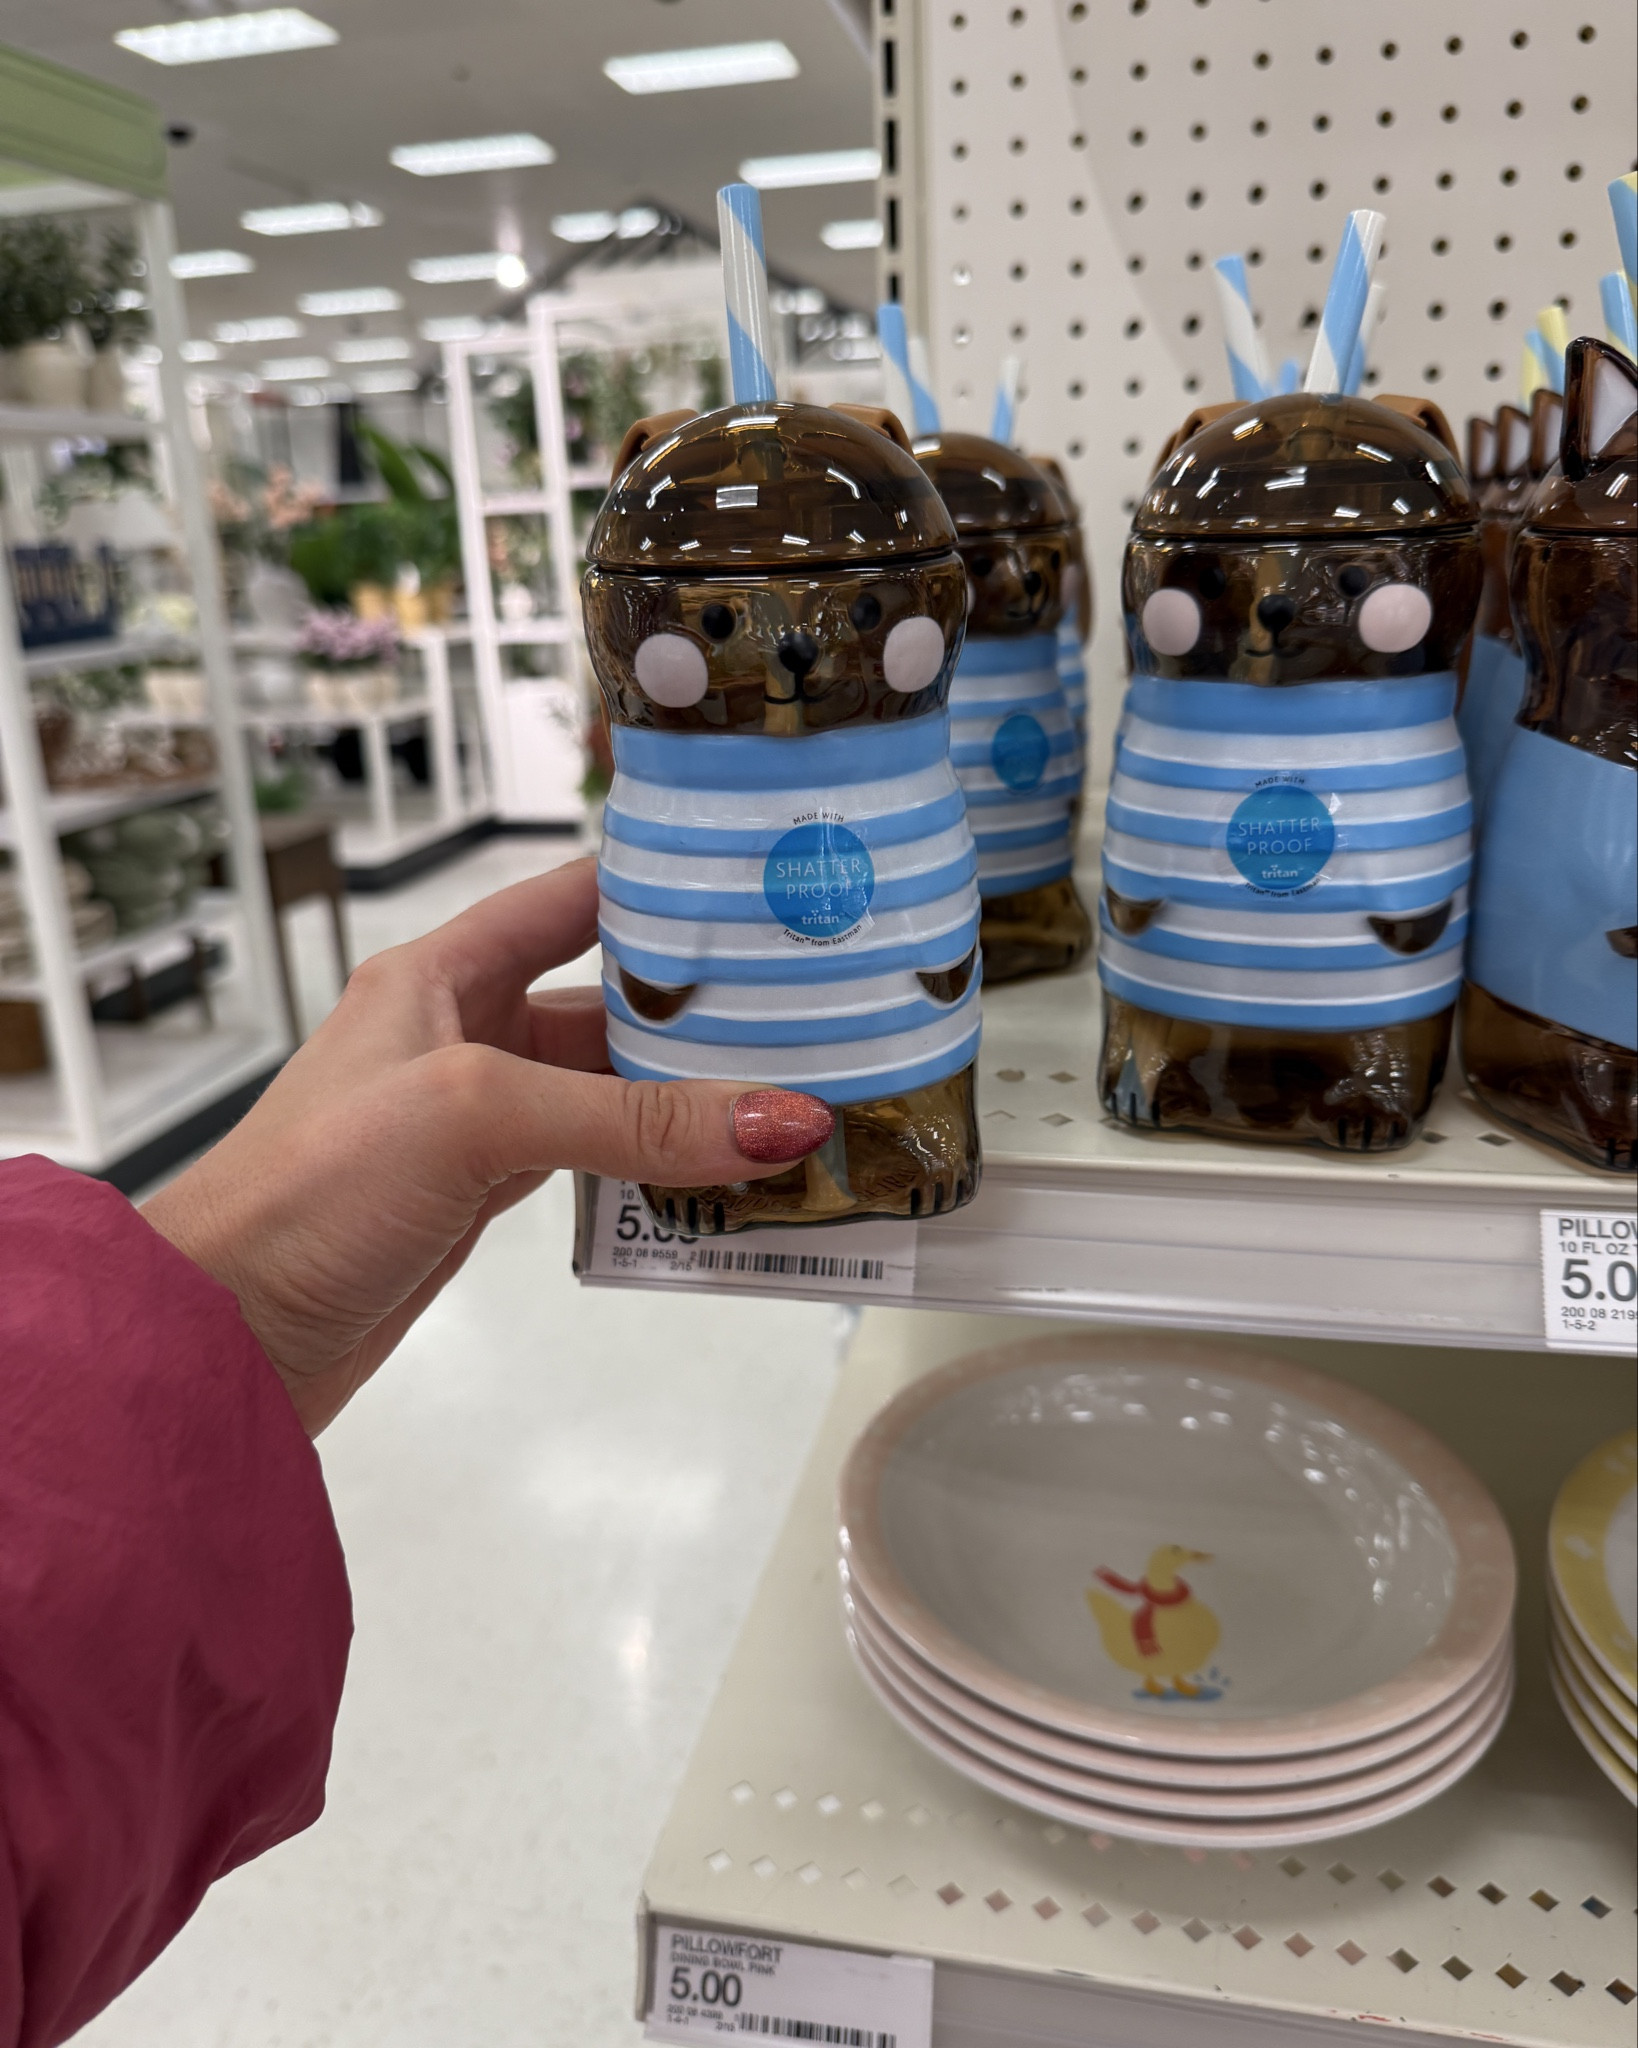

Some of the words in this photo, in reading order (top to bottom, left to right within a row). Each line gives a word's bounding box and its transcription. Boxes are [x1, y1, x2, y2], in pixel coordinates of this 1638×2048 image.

[1255, 776, 1279, 788] MADE
[1282, 776, 1305, 784] WITH
[793, 812, 819, 825] MADE
[822, 812, 845, 823] WITH
[1238, 817, 1321, 837] SHATTER
[1247, 837, 1312, 856] PROOF
[776, 858, 861, 878] SHATTER
[786, 879, 853, 900] PROOF
[811, 937, 830, 946] from
[832, 924, 862, 945] Eastman
[621, 1189, 635, 1200] 10
[616, 1204, 700, 1245] 5.
[612, 1246, 633, 1257] 200
[636, 1248, 649, 1258] 08
[1559, 1241, 1577, 1253] 10
[1582, 1242, 1601, 1255] FL
[1605, 1243, 1629, 1256] OZ
[1561, 1306, 1586, 1318] 200
[1590, 1307, 1606, 1319] 08
[1610, 1308, 1637, 1321] 219
[1562, 1319, 1596, 1331] 1-5-2
[671, 1933, 784, 1963] PILLOWFORT
[670, 1951, 710, 1967] DINING
[712, 1957, 745, 1972] BOWL
[670, 1965, 743, 2007] 5.00
